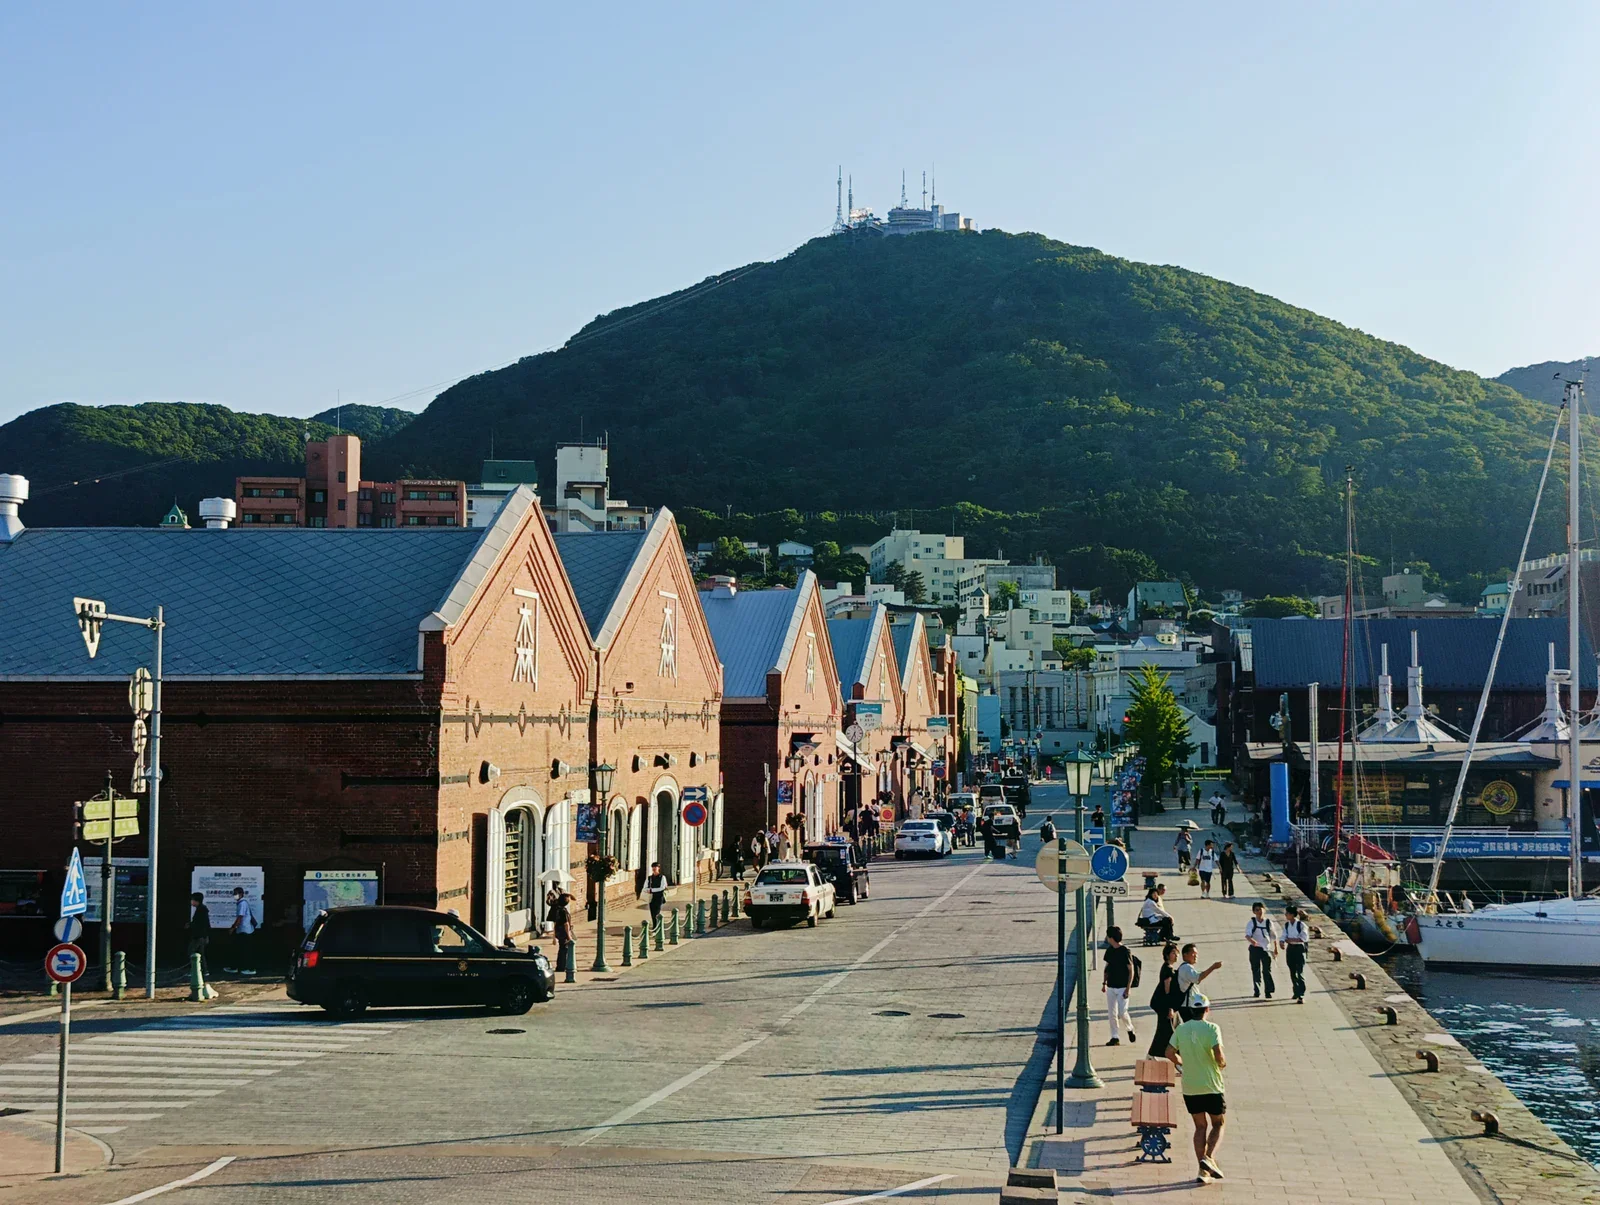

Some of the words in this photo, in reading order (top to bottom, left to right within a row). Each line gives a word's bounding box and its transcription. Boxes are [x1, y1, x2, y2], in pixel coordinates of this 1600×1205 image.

[1094, 885, 1126, 895] ここから
[1435, 919, 1465, 929] えとも
